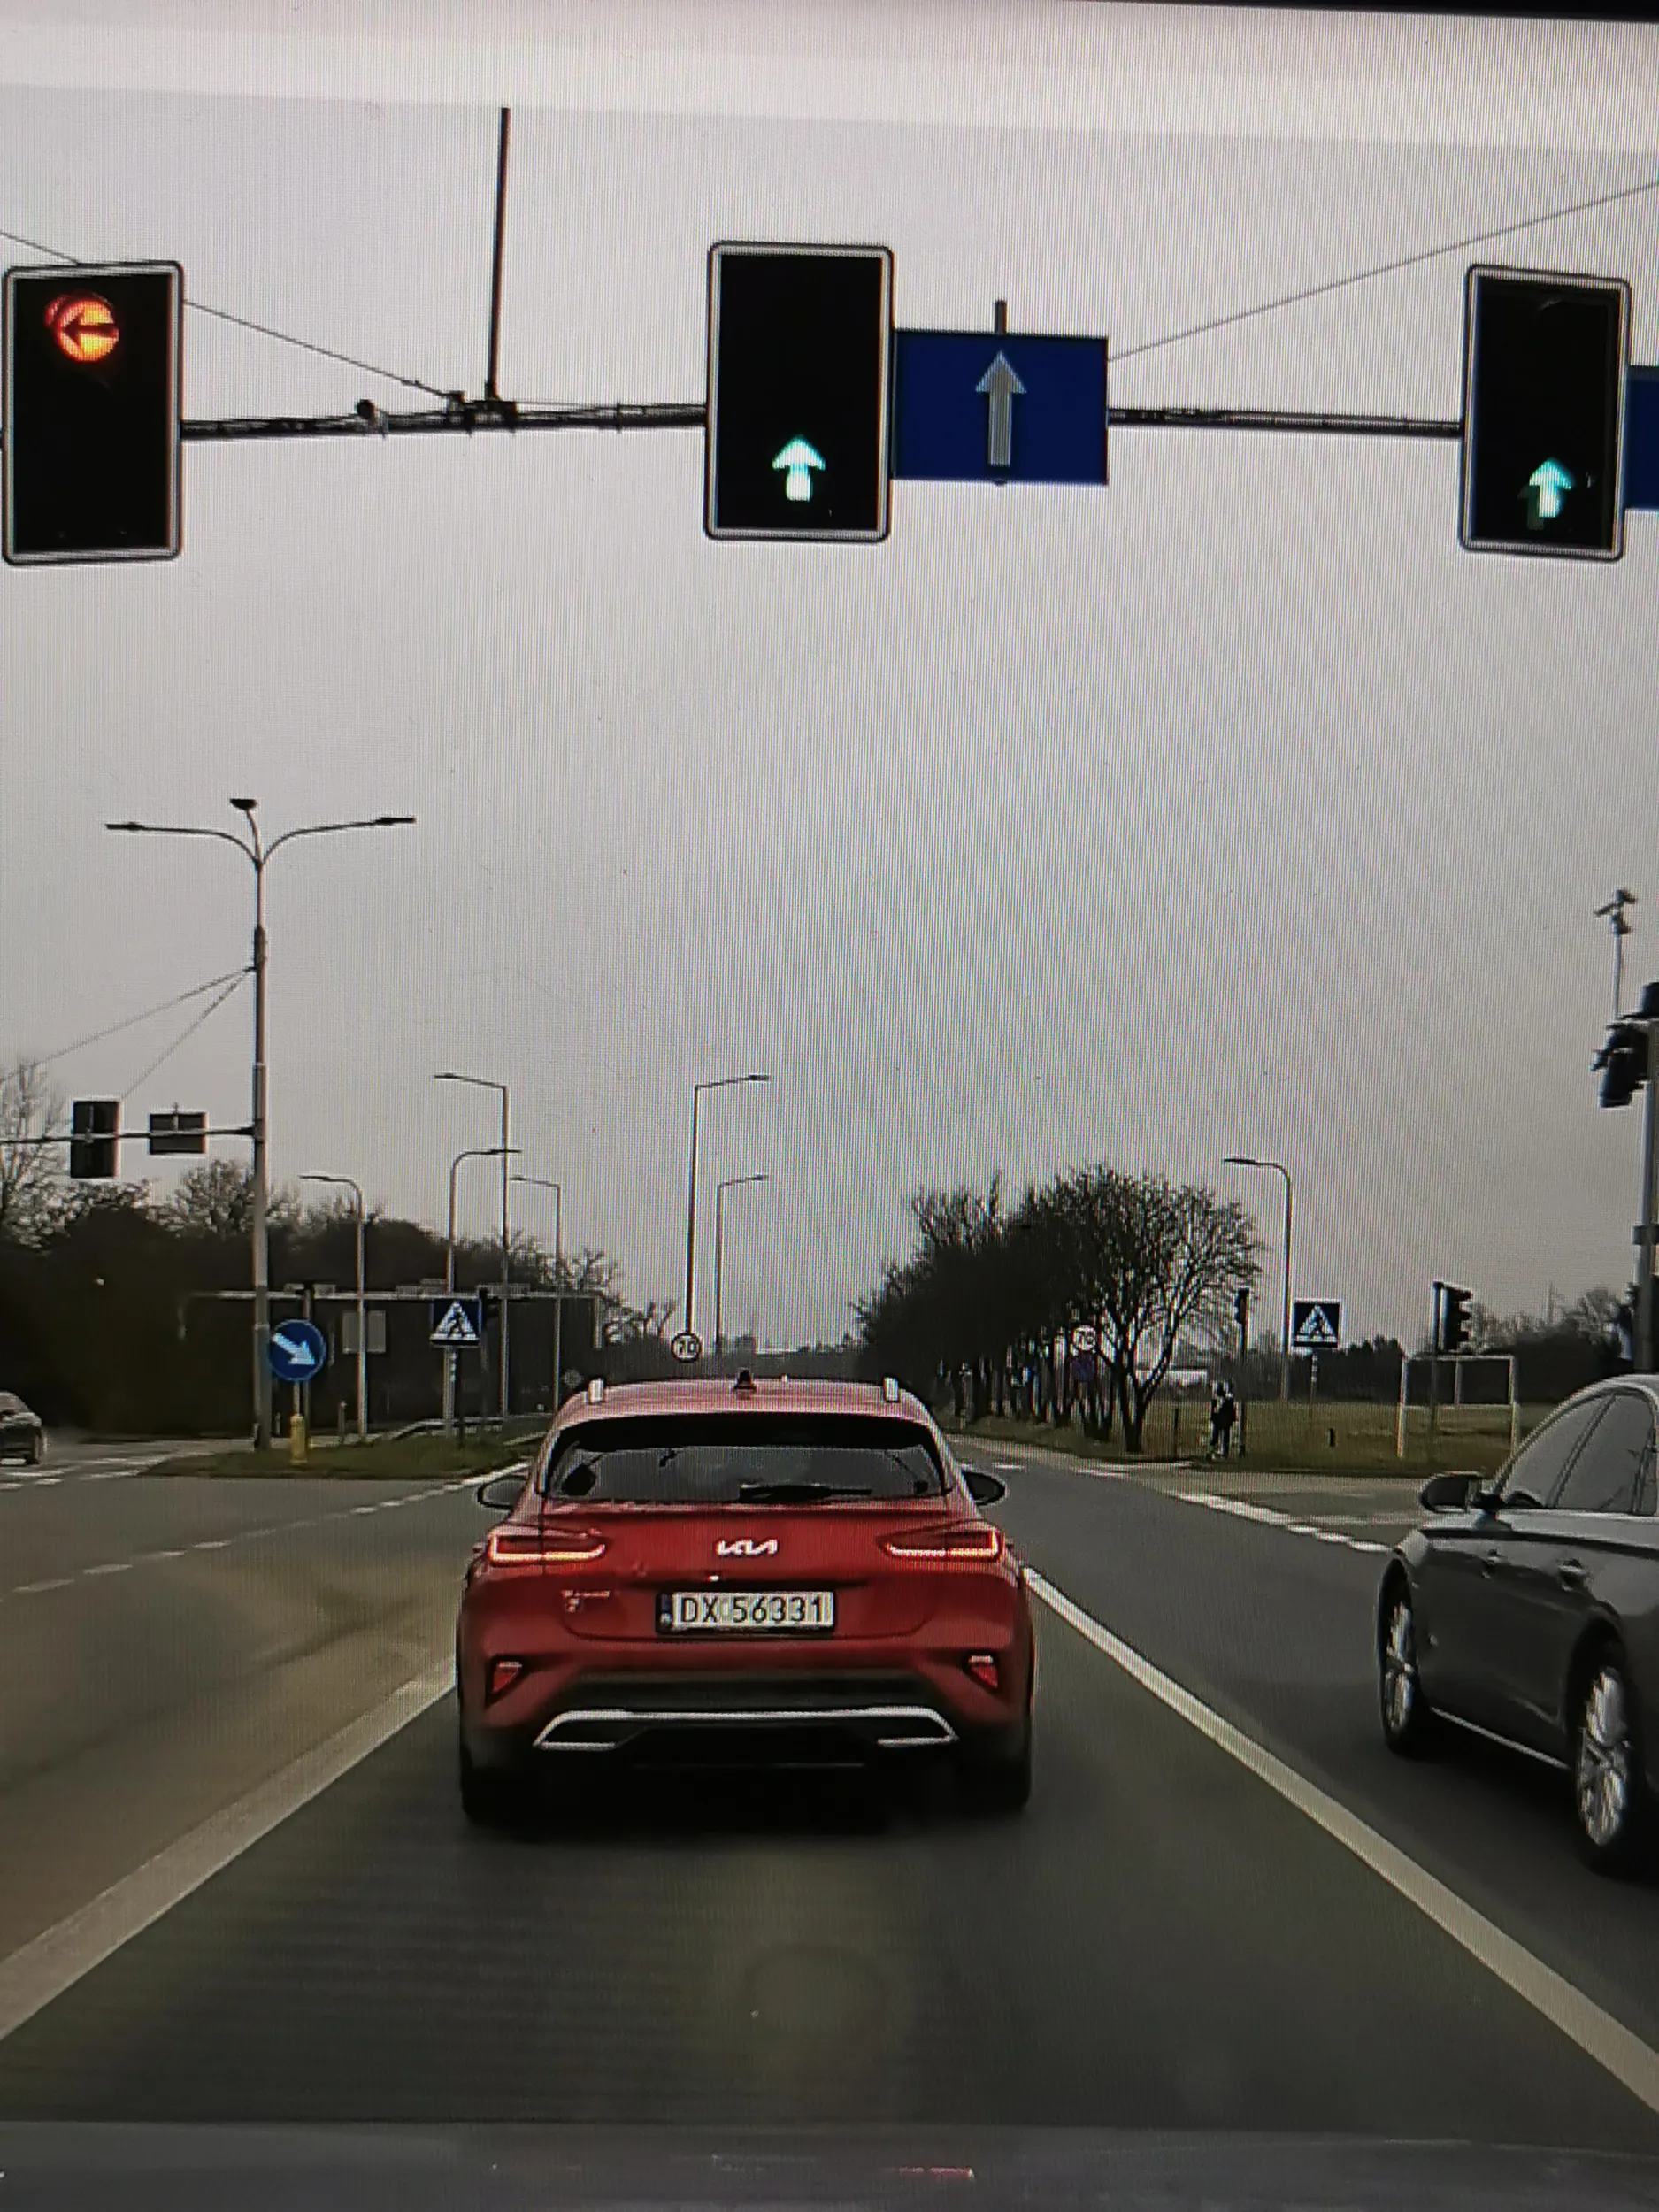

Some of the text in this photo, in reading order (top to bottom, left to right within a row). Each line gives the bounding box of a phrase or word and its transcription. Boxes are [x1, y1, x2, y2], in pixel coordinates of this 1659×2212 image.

[676, 1339, 697, 1356] 70
[680, 1596, 821, 1623] DX 56331
